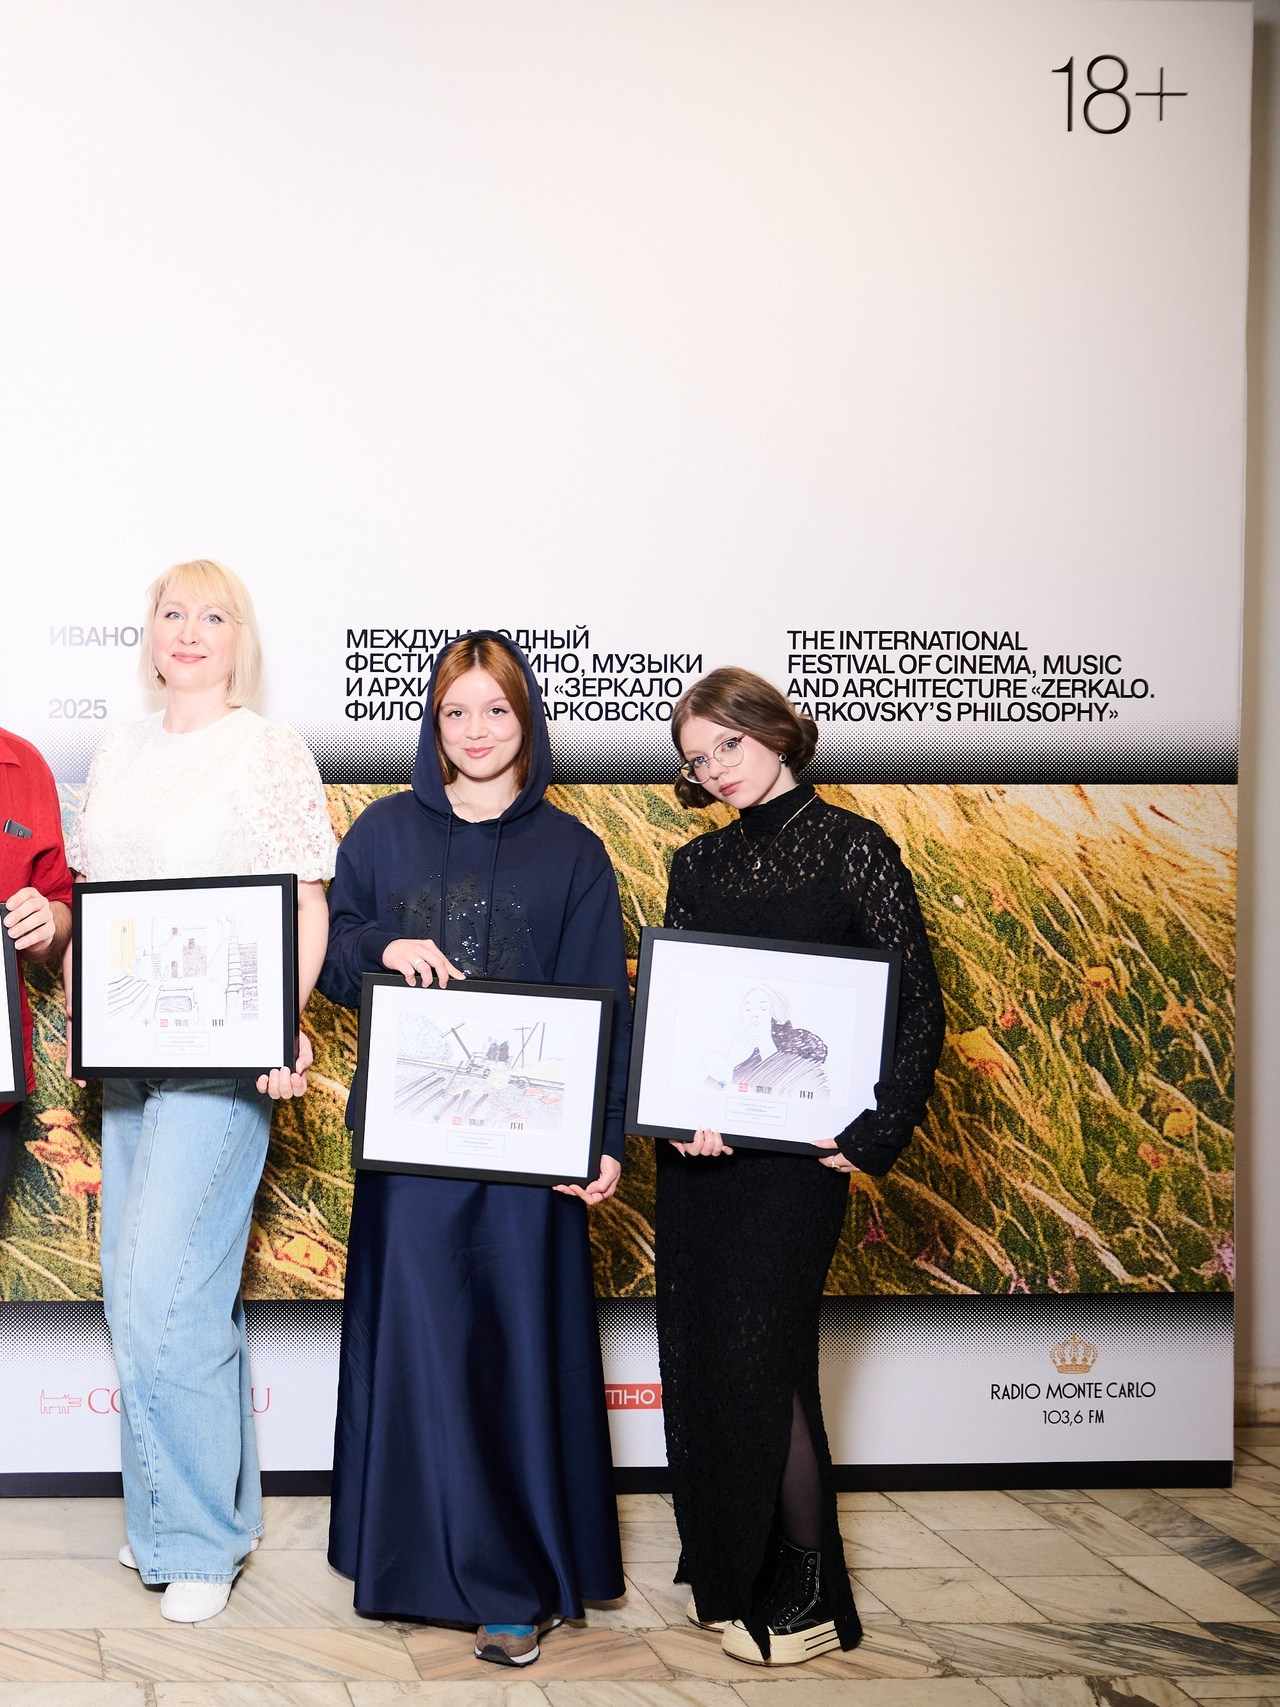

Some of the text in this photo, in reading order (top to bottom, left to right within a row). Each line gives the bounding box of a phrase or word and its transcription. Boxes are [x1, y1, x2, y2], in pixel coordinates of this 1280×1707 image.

[1052, 54, 1189, 135] 18+
[49, 626, 144, 647] ИВАНО
[787, 630, 1029, 651] THE INTERNATIONAL
[345, 653, 434, 673] ФЕСТИ
[592, 653, 703, 674] МУЗЫКИ
[788, 653, 1123, 678] FESTIVAL OF CINEMA, MUSIC
[346, 677, 363, 697] И
[786, 677, 1155, 699] AND ARCHITECTURE «ZERKALO.
[48, 698, 108, 719] 2025
[345, 701, 424, 721] ФИЛО
[957, 701, 1119, 722] PHILOSOPHY»
[991, 1381, 1157, 1400] RADIO MONTE CARLO
[1042, 1410, 1105, 1427] 103,6 FM
